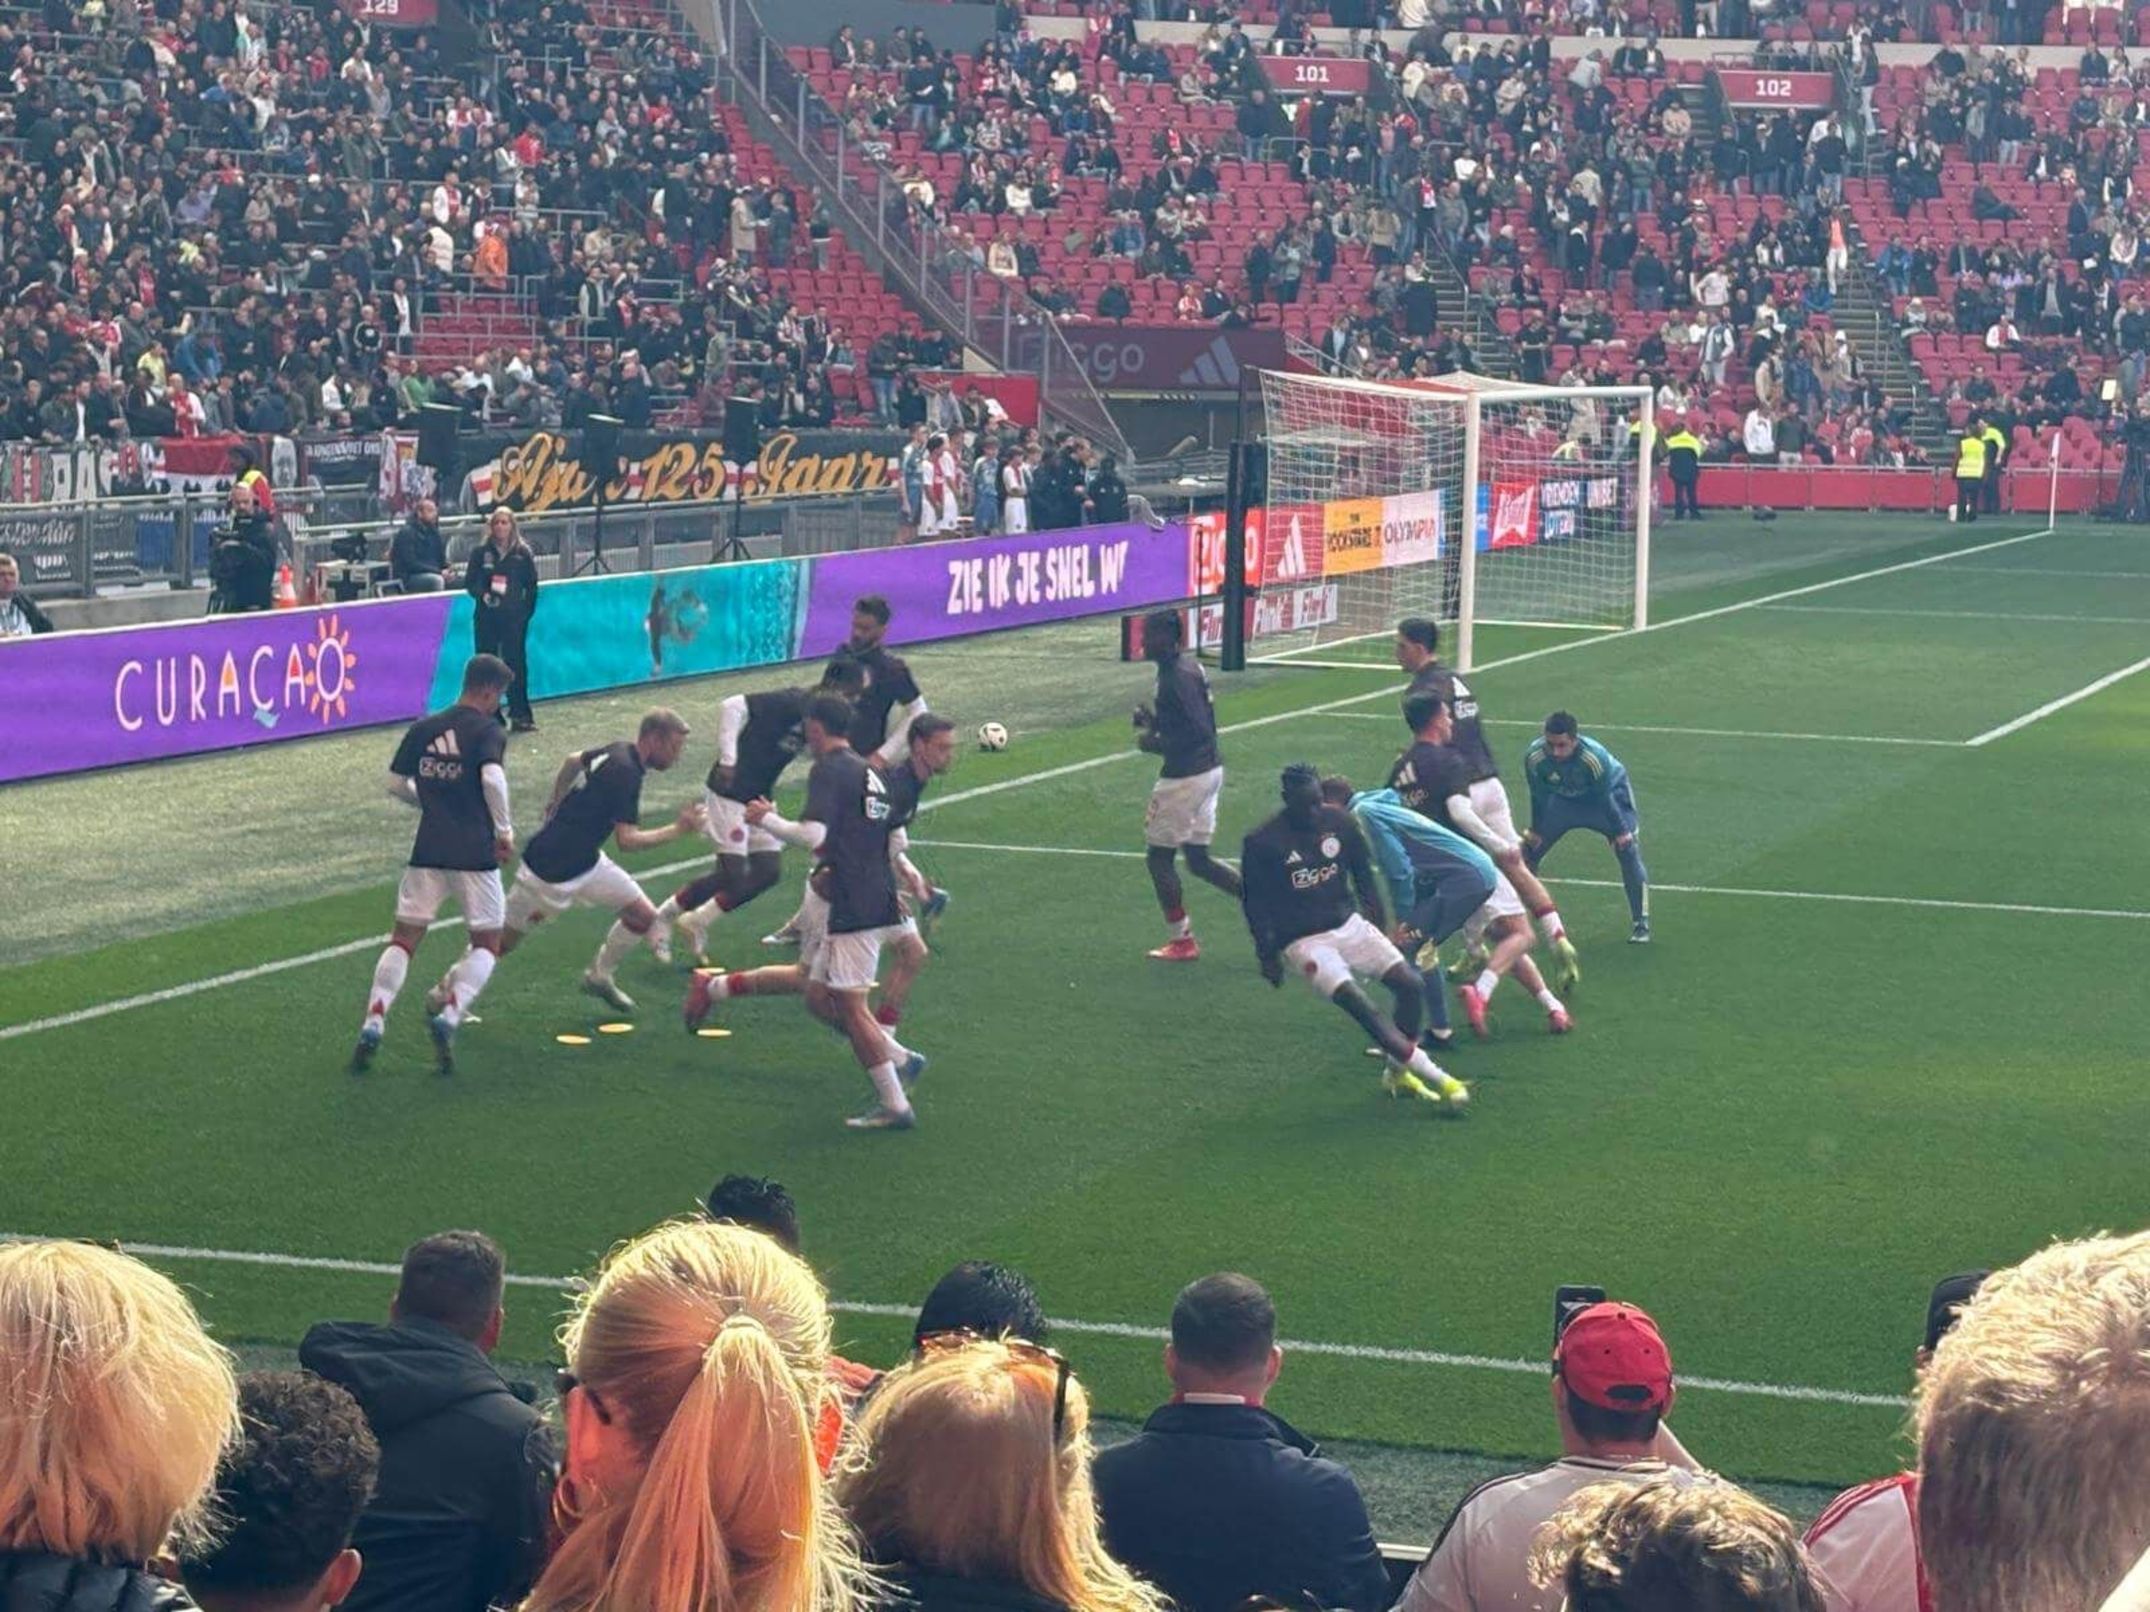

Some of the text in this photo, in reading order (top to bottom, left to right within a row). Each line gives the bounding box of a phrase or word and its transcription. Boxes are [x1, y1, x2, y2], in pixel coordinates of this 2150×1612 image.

[360, 0, 399, 15] 129
[1295, 65, 1330, 82] 101
[1755, 79, 1792, 97] 102
[642, 442, 726, 501] 125
[742, 433, 886, 505] Jaar
[1383, 518, 1436, 545] OLYMPIA
[947, 558, 983, 614] ZIE
[988, 553, 1011, 609] IK
[1015, 551, 1041, 606] JE
[1045, 543, 1096, 601] SNEL
[1292, 862, 1339, 889] Ziggo
